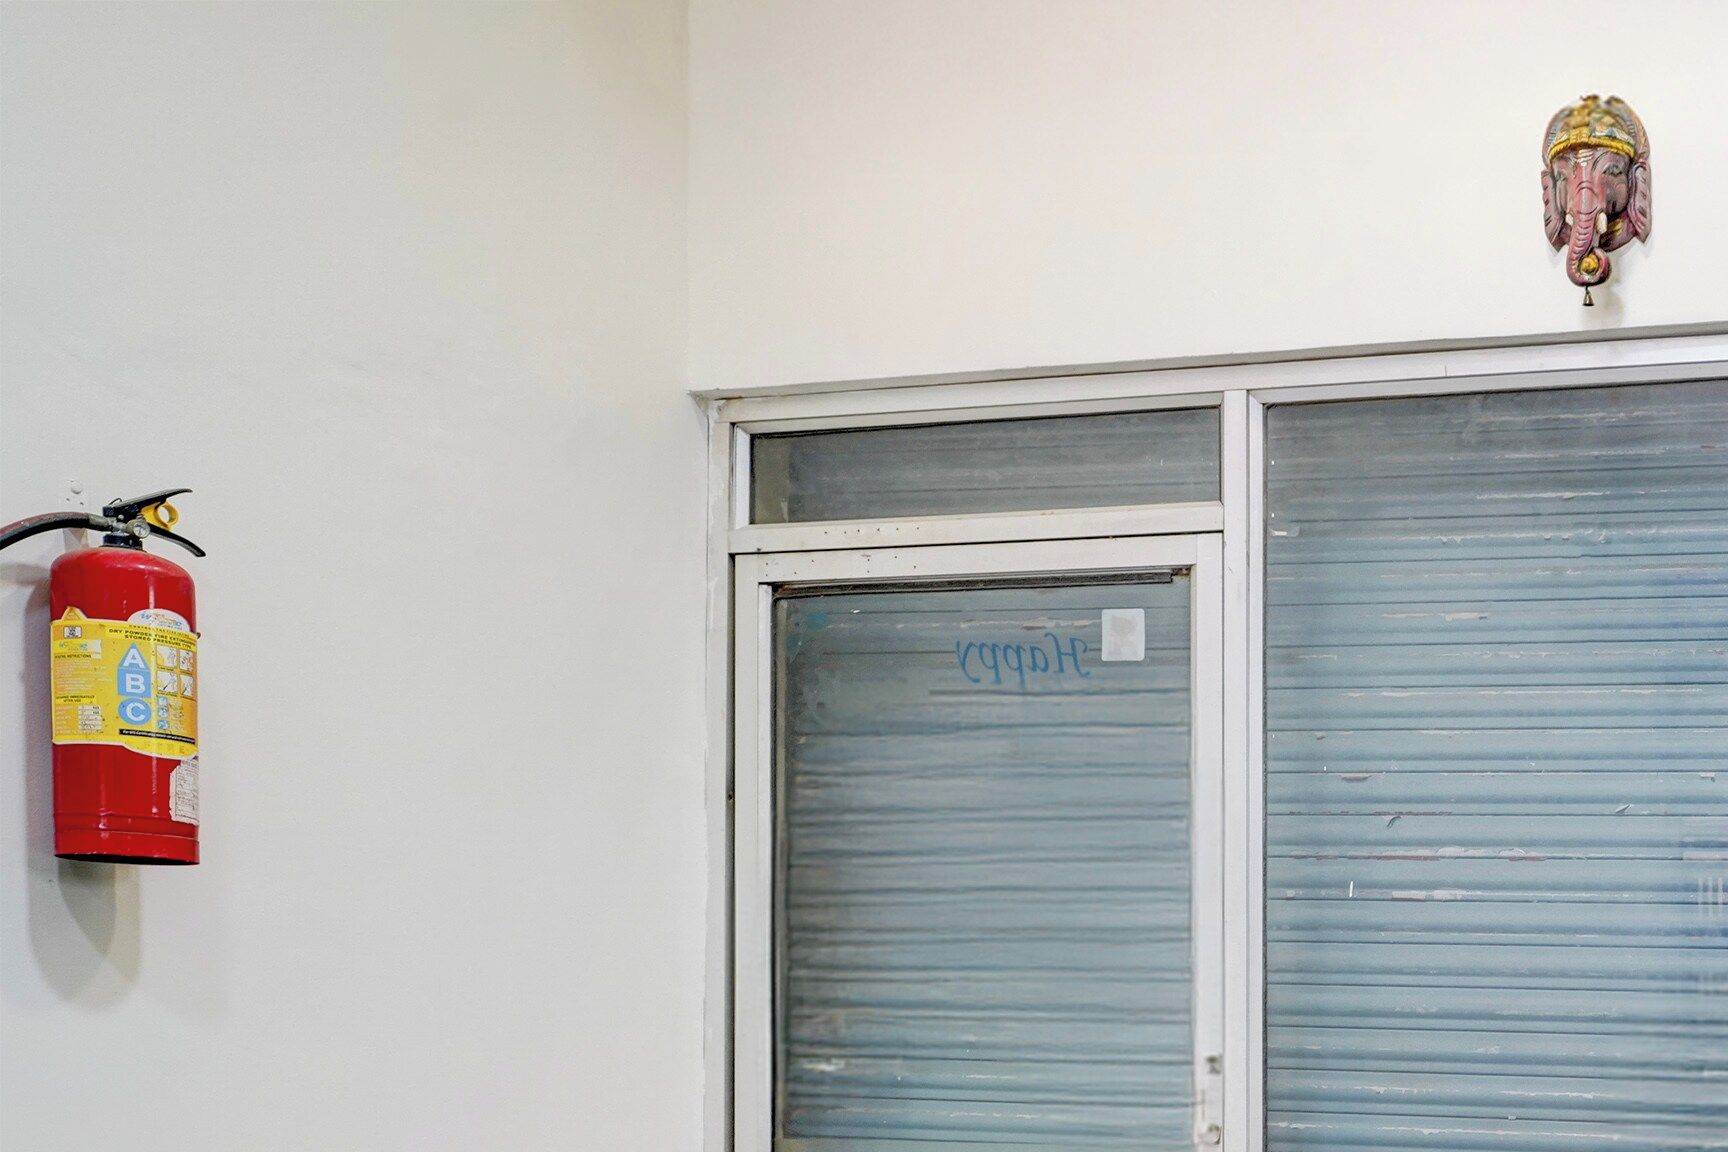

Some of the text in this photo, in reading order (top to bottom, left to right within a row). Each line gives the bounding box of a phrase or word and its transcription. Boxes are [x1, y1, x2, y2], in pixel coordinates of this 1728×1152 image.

[122, 648, 146, 669] A
[125, 673, 146, 694] B
[125, 702, 146, 722] C
